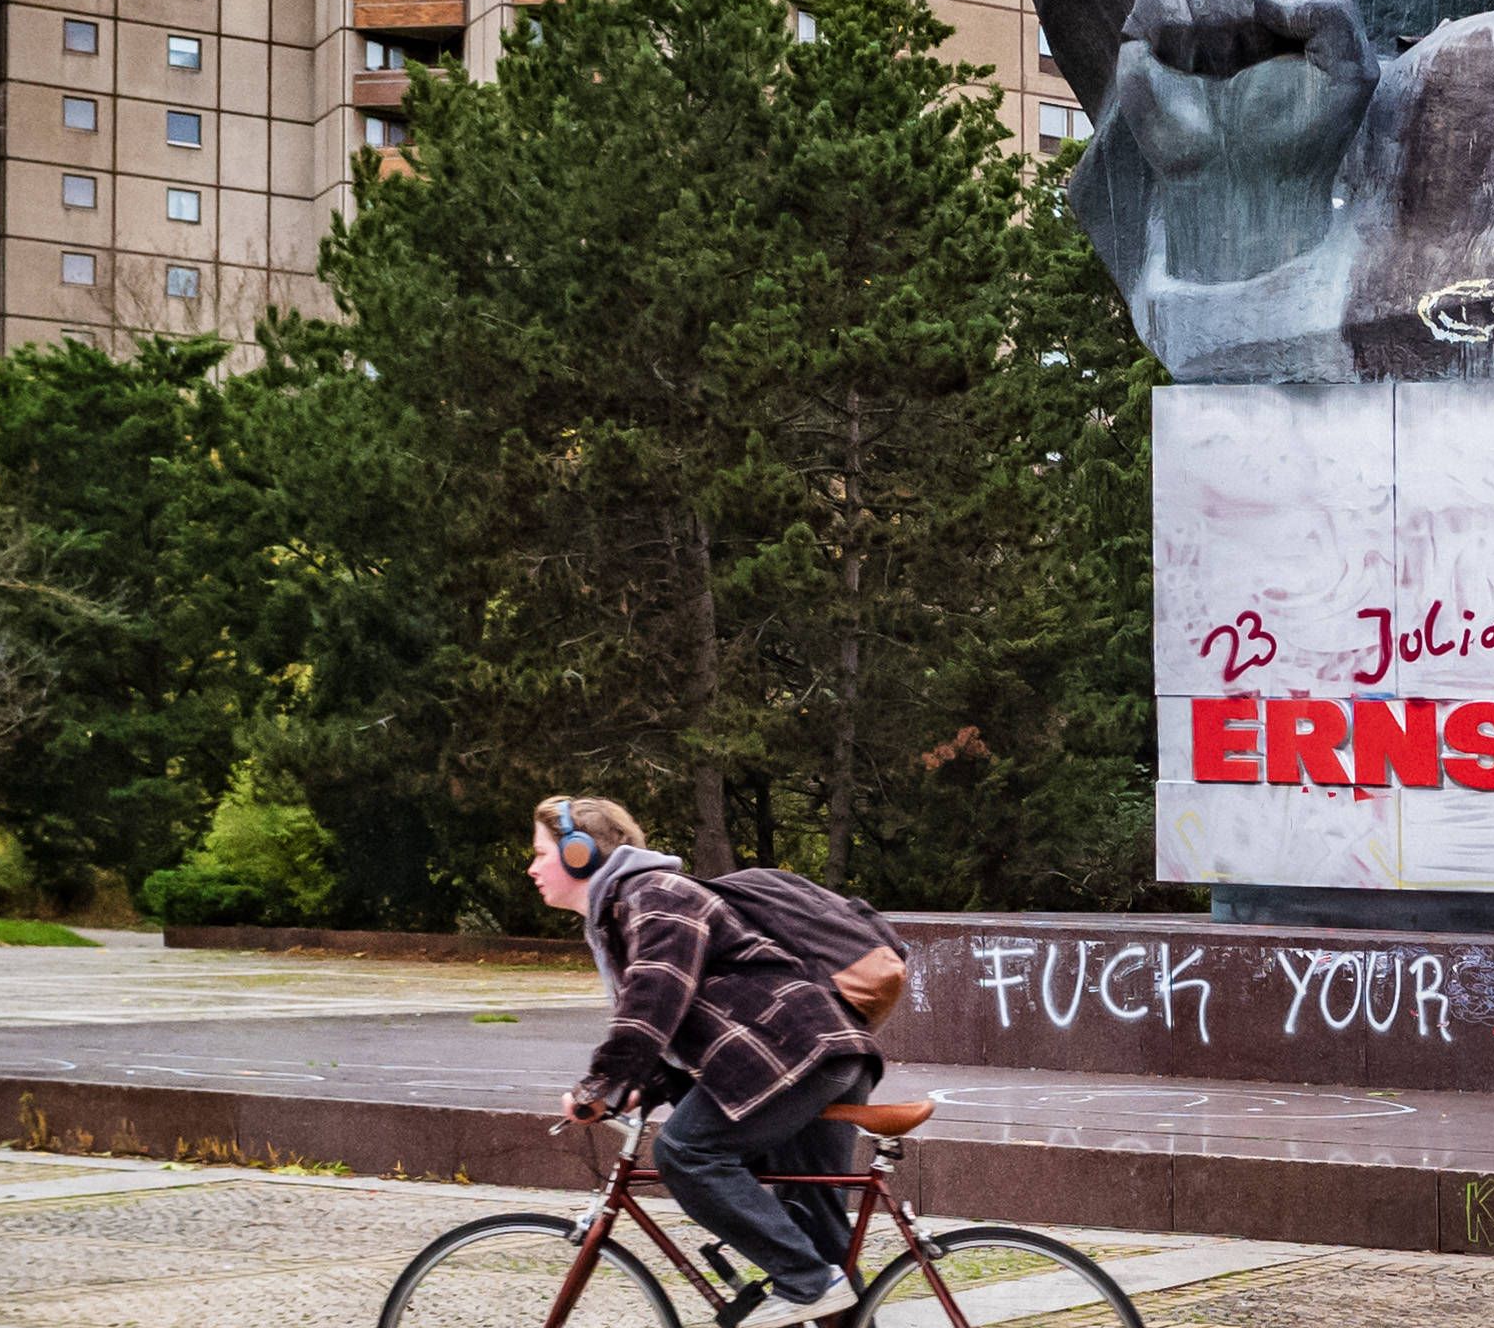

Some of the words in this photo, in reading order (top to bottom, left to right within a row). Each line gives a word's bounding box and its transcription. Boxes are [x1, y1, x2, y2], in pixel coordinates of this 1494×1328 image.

[1200, 610, 1277, 682] 23
[972, 941, 1211, 1044] FUCK
[1277, 948, 1453, 1042] YOUR
